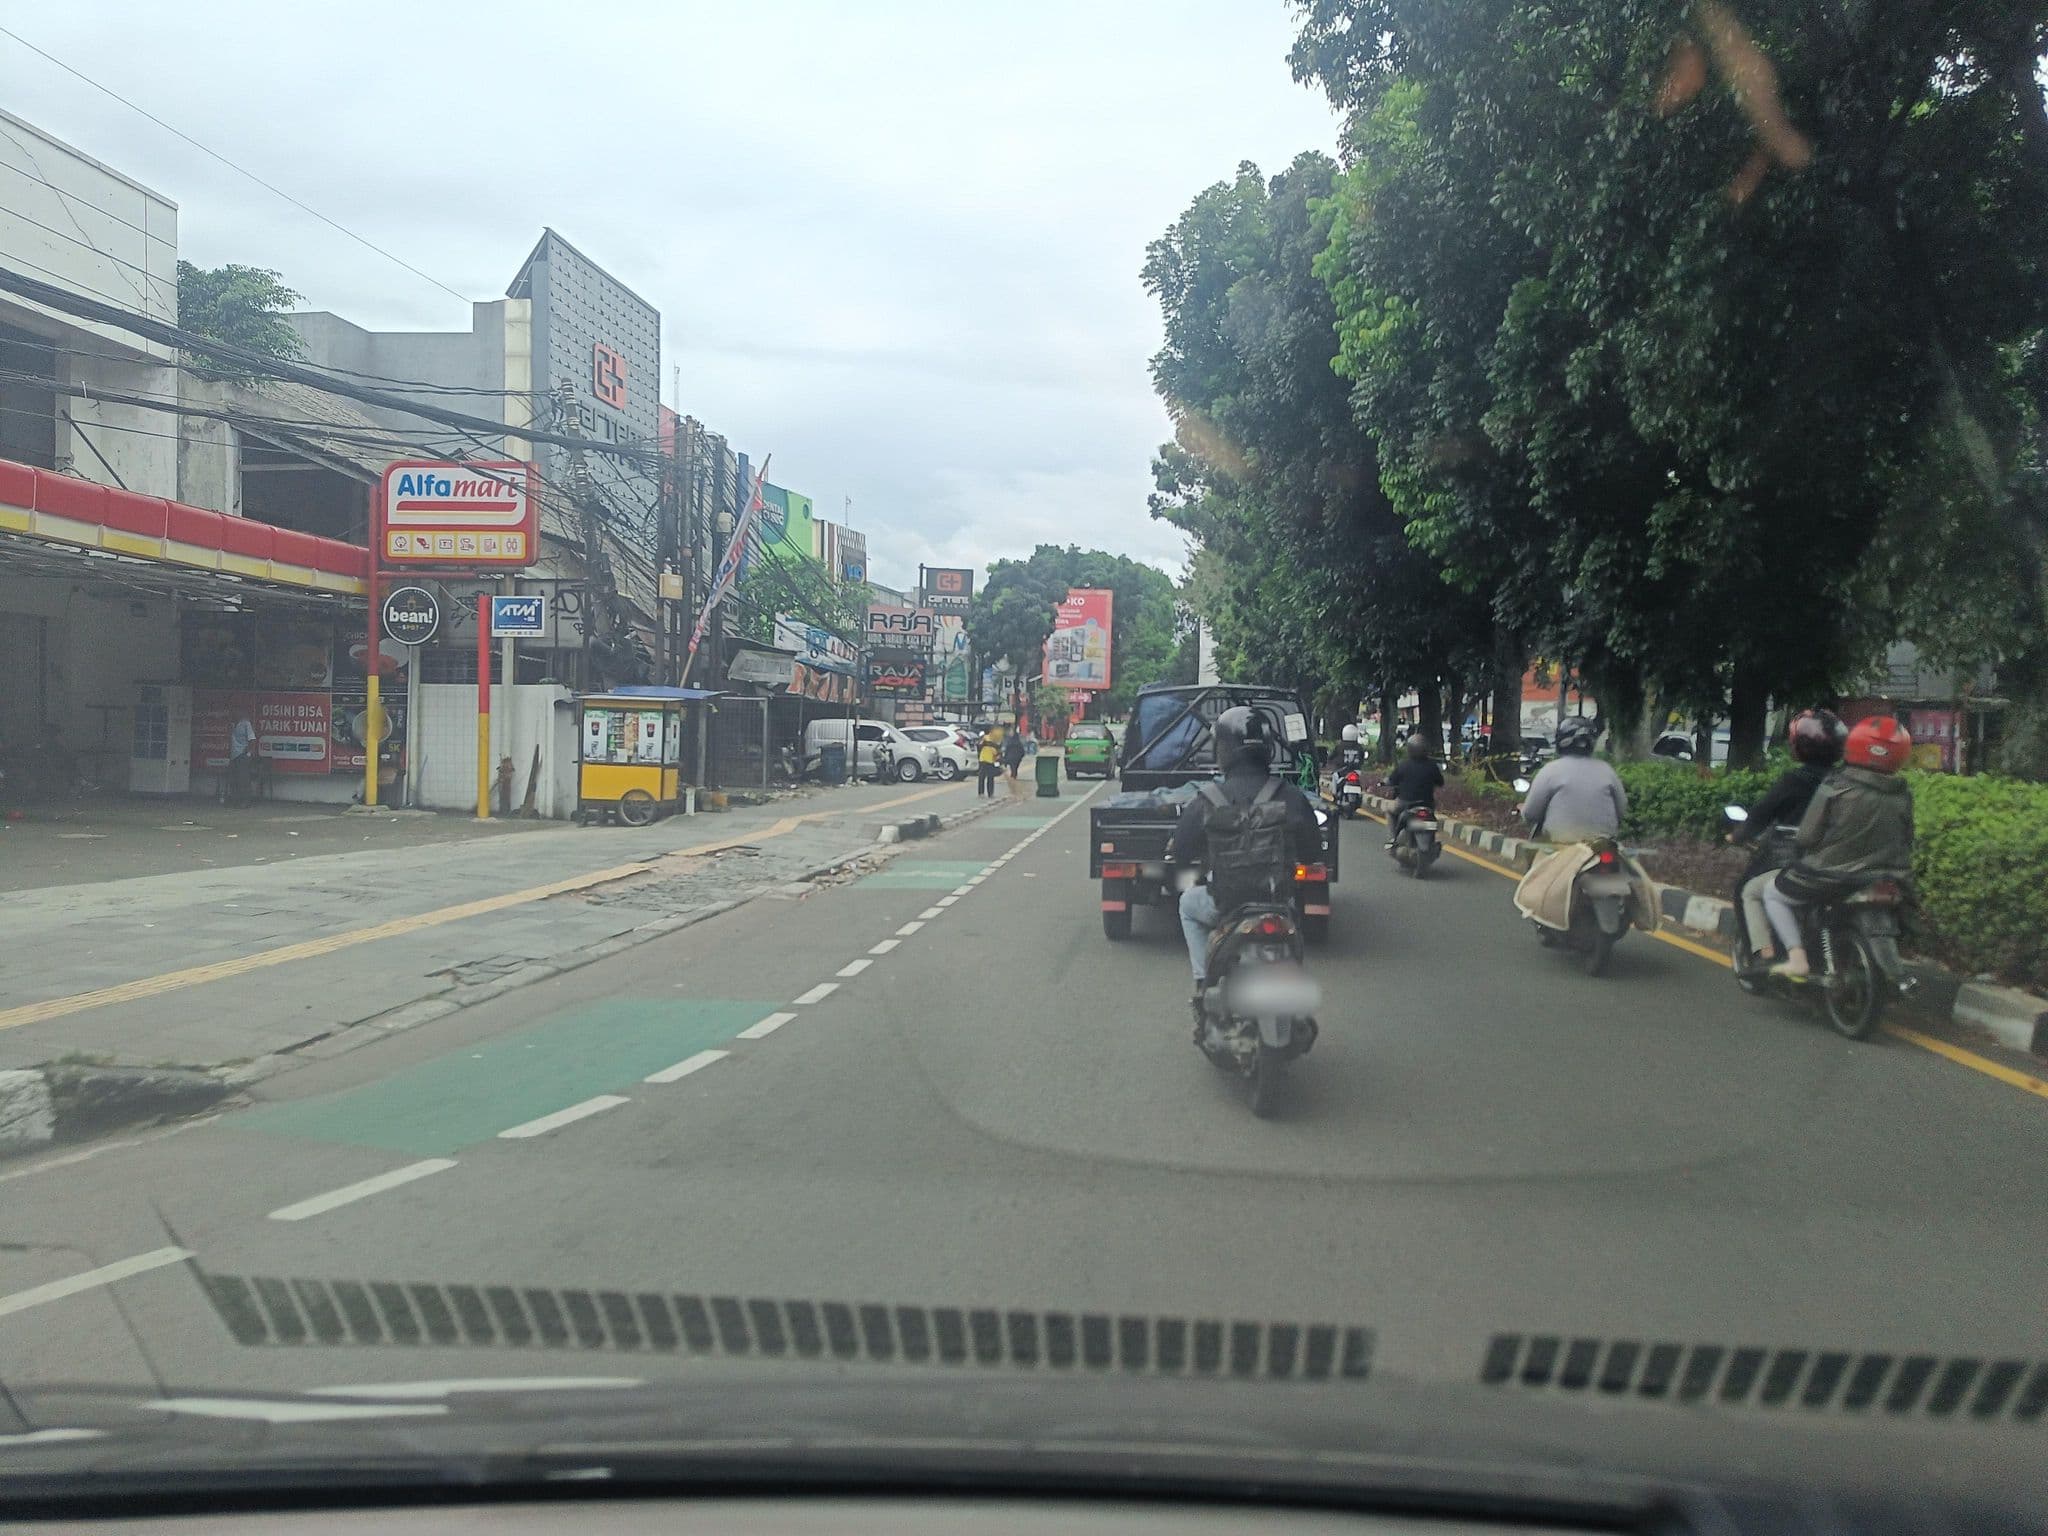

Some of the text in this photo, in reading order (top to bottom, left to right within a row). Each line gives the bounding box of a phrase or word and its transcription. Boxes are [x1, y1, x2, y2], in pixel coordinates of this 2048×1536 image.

[397, 474, 517, 498] Alfamart
[389, 606, 433, 624] bean!
[498, 604, 536, 616] ATM
[868, 609, 932, 633] RAJA
[869, 664, 921, 678] RAJA
[262, 704, 324, 717] DISINI BISA
[259, 719, 327, 732] TARIK TUNAI
